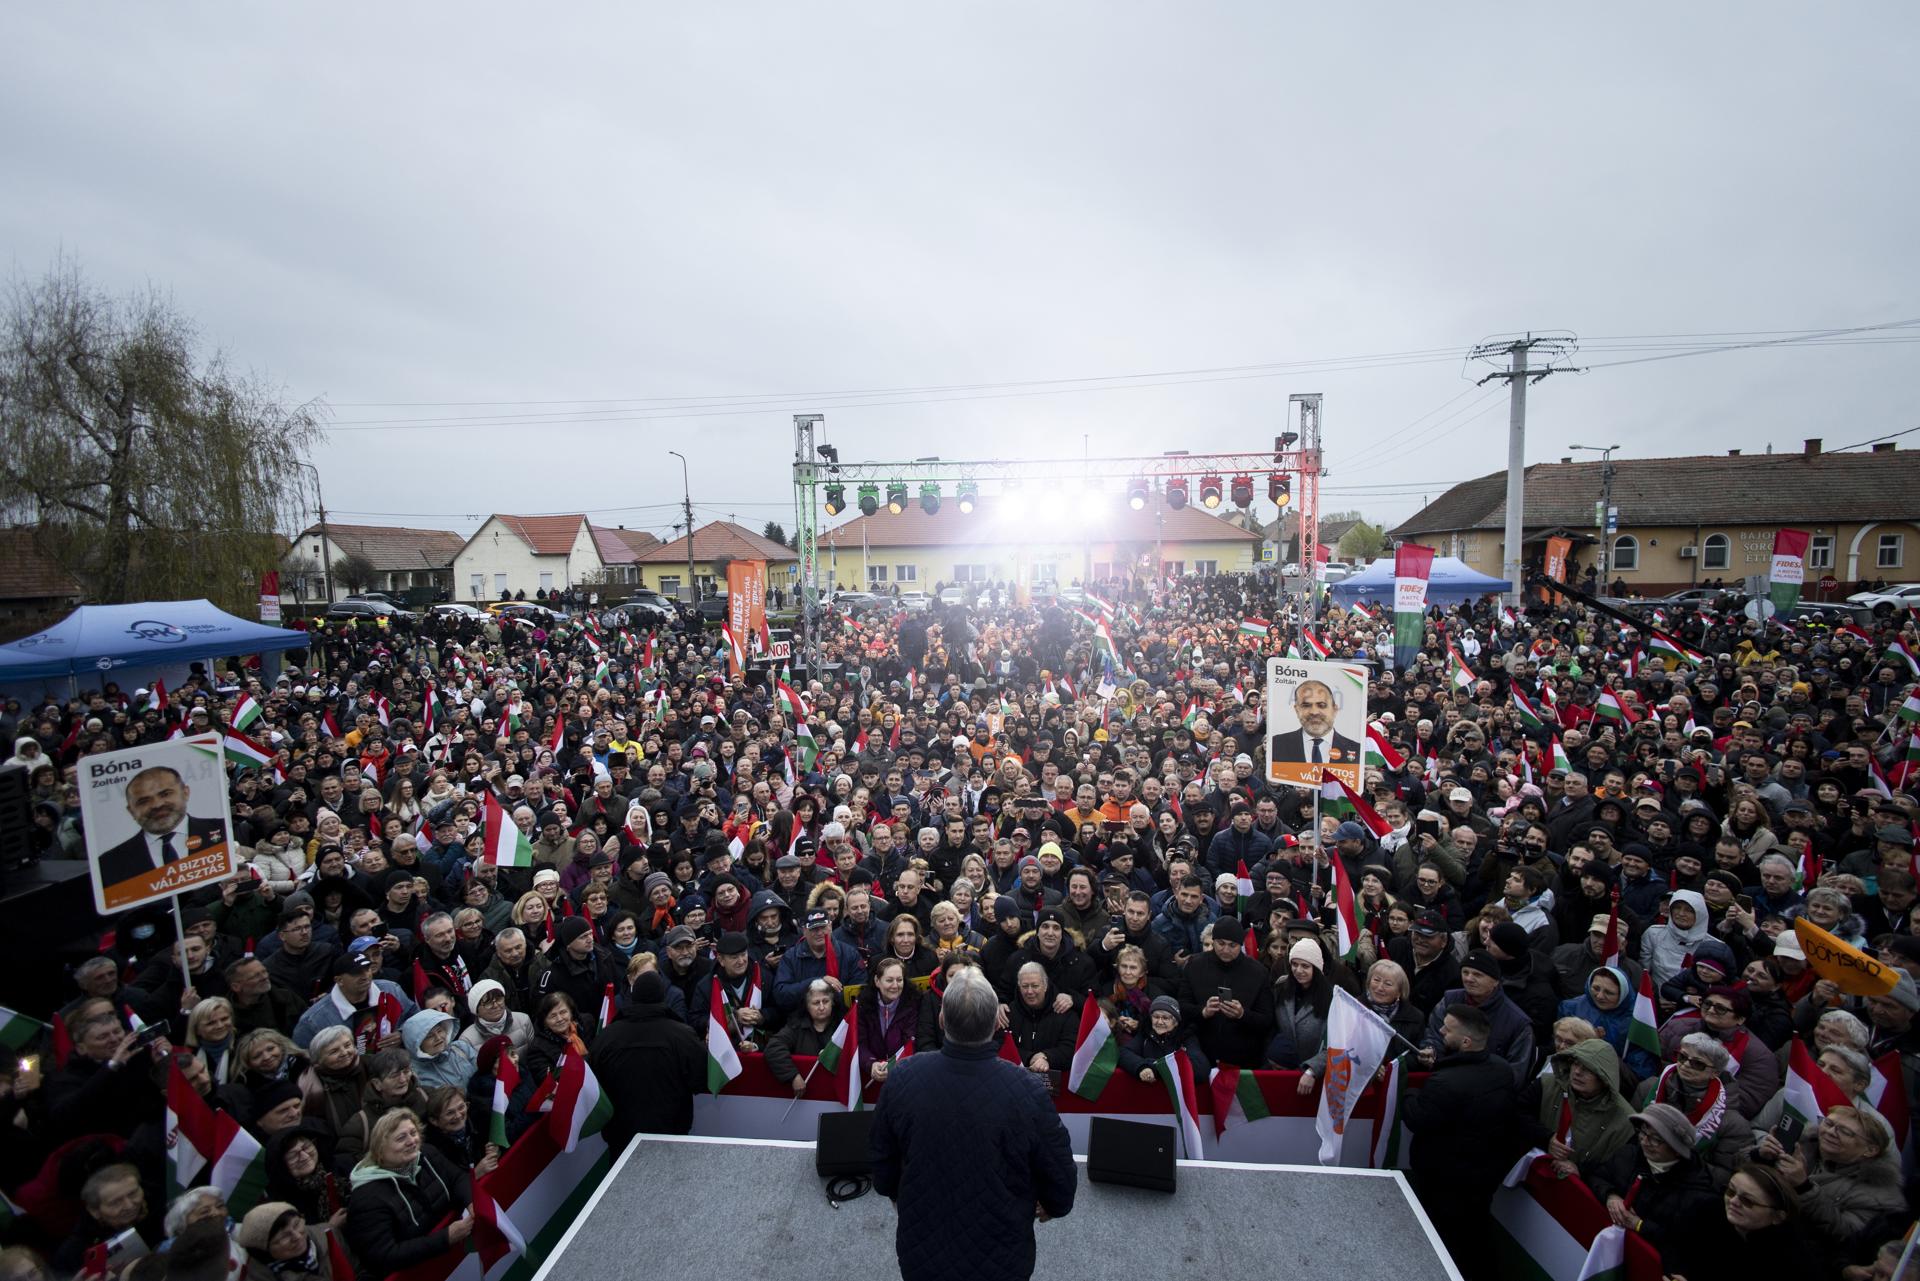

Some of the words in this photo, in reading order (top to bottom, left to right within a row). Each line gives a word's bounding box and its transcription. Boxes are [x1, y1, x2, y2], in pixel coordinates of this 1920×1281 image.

[1776, 560, 1803, 568] FIDES
[733, 592, 744, 633] FIDESZ
[1275, 665, 1308, 678] Bóna
[1274, 677, 1297, 686] Zoltán
[90, 758, 143, 778] Bóna
[1312, 765, 1320, 773] A
[92, 776, 127, 789] Zoltán
[1299, 771, 1355, 788] VÁLÁS
[166, 866, 177, 876] A
[178, 851, 225, 872] BIZTOS
[150, 862, 226, 891] VÁLASZTÁS
[1805, 938, 1881, 977] DÖMSÖD
